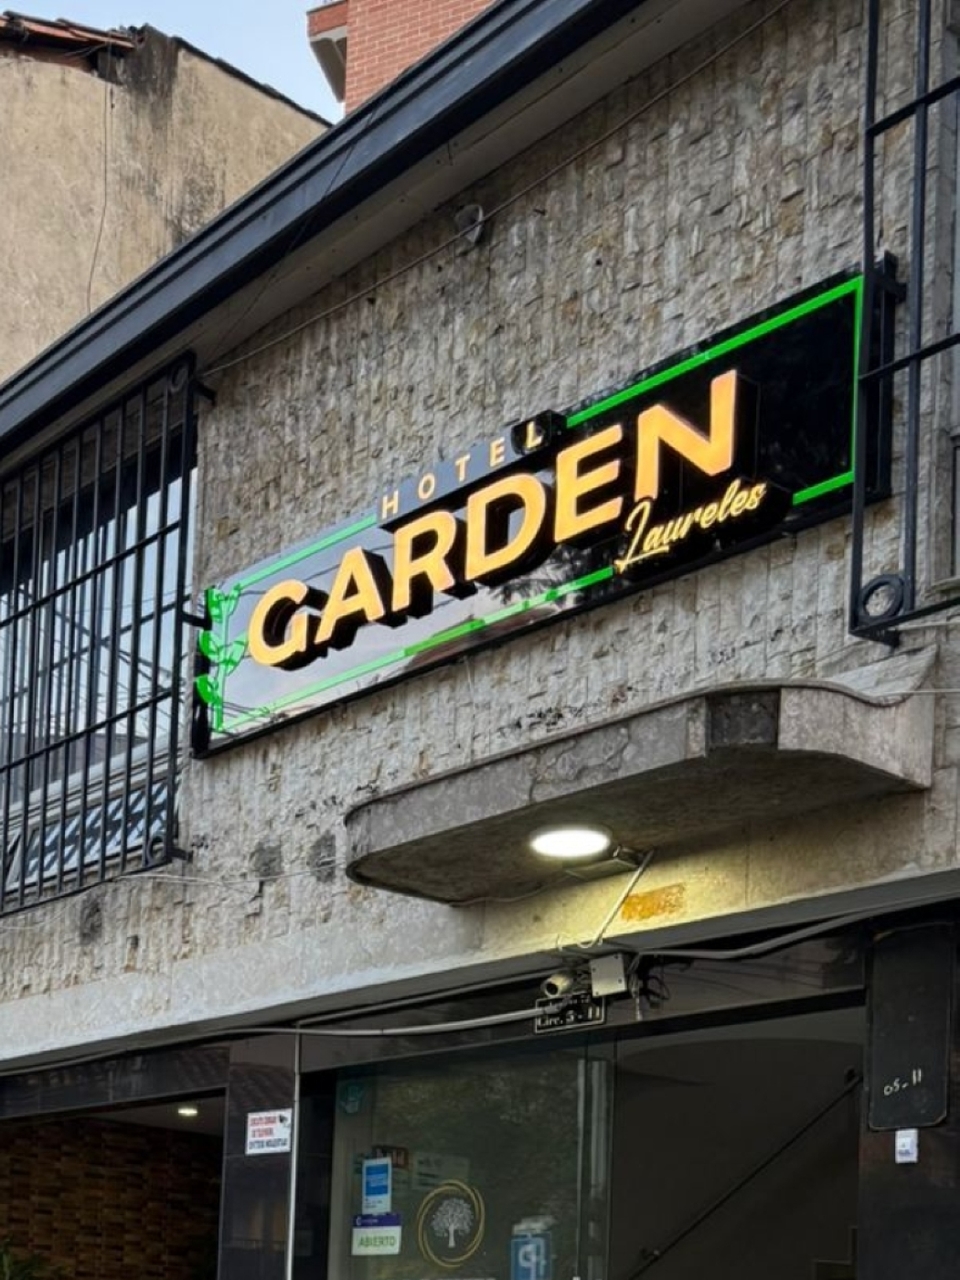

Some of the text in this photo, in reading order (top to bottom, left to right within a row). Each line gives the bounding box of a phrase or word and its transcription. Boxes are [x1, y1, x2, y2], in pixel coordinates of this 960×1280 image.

[248, 369, 737, 666] GARDEN
[382, 421, 543, 519] HOTEL
[614, 478, 767, 574] Laureles
[357, 1235, 397, 1248] ABIERTO
